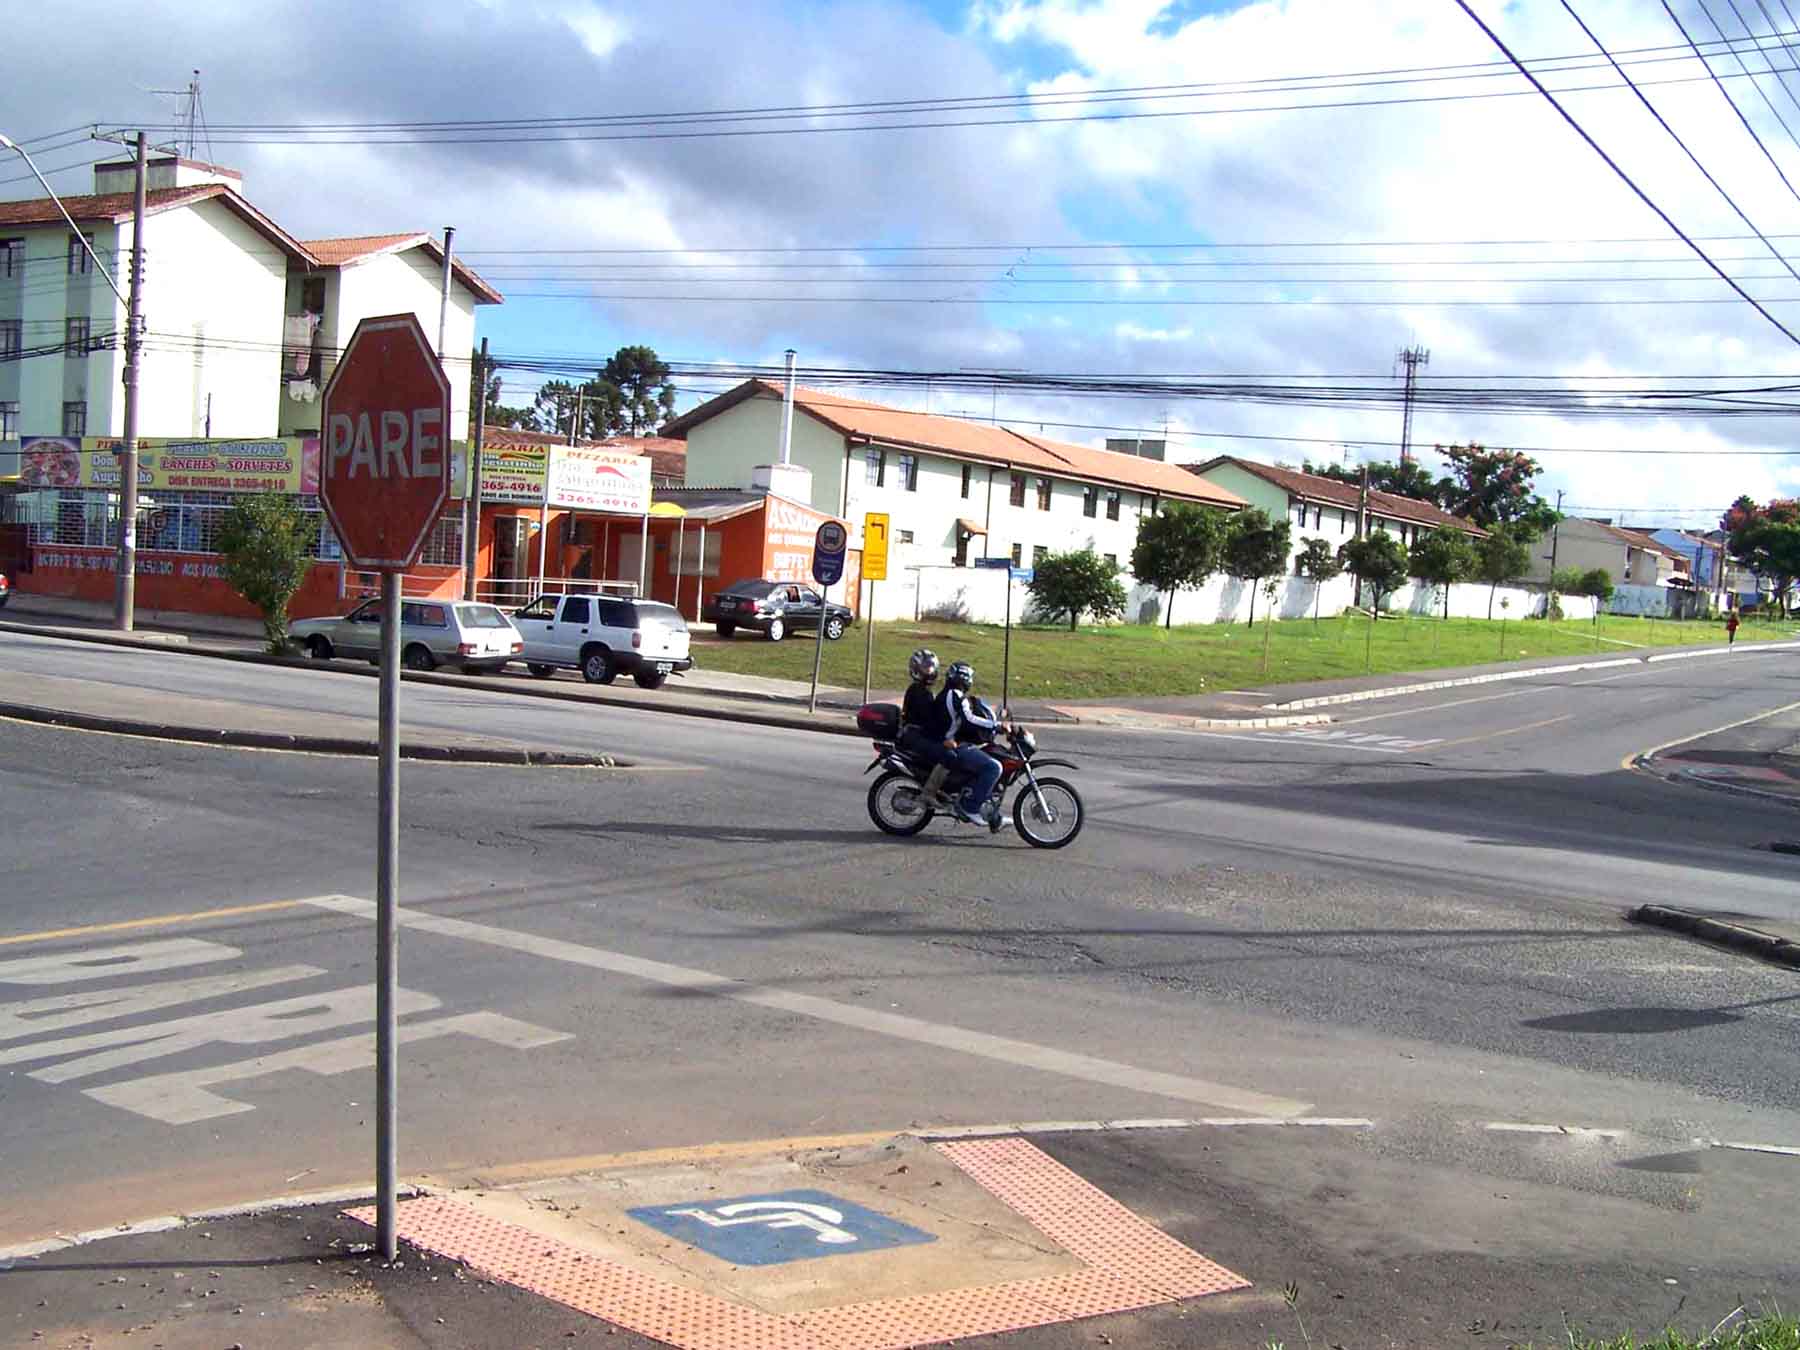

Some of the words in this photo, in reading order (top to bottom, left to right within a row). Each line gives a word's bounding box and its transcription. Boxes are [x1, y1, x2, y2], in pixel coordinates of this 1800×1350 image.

[327, 408, 441, 479] PARE
[483, 443, 545, 453] IZZARIA
[567, 451, 638, 466] PIZZARIA
[227, 459, 292, 473] SORVETES
[482, 481, 541, 493] 365-4916
